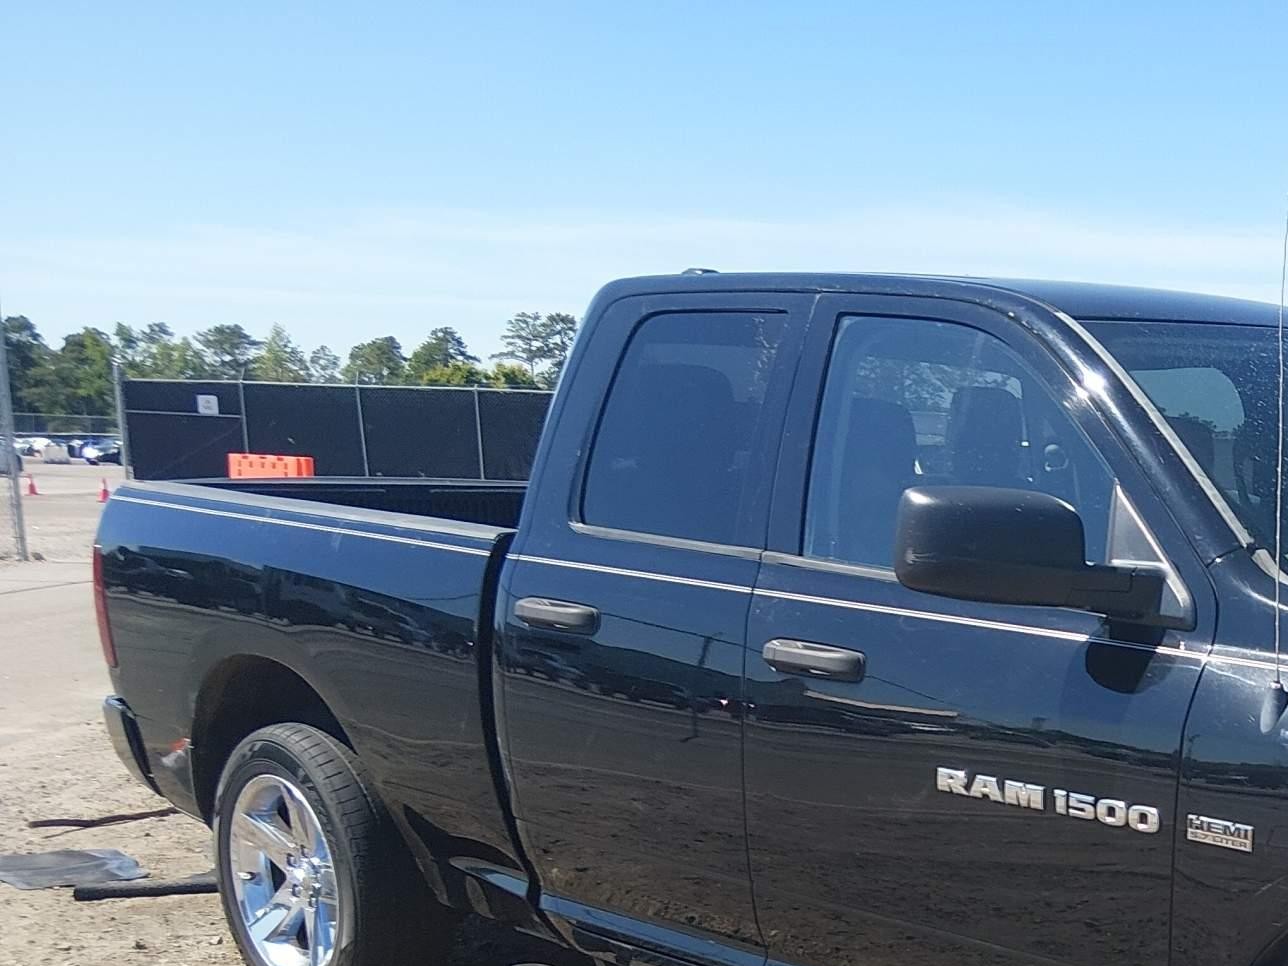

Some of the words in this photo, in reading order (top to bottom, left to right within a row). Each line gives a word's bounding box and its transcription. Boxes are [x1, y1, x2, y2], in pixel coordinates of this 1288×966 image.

[936, 766, 1046, 811] RAM
[1053, 789, 1160, 834] 1500
[1187, 814, 1254, 841] HEMI
